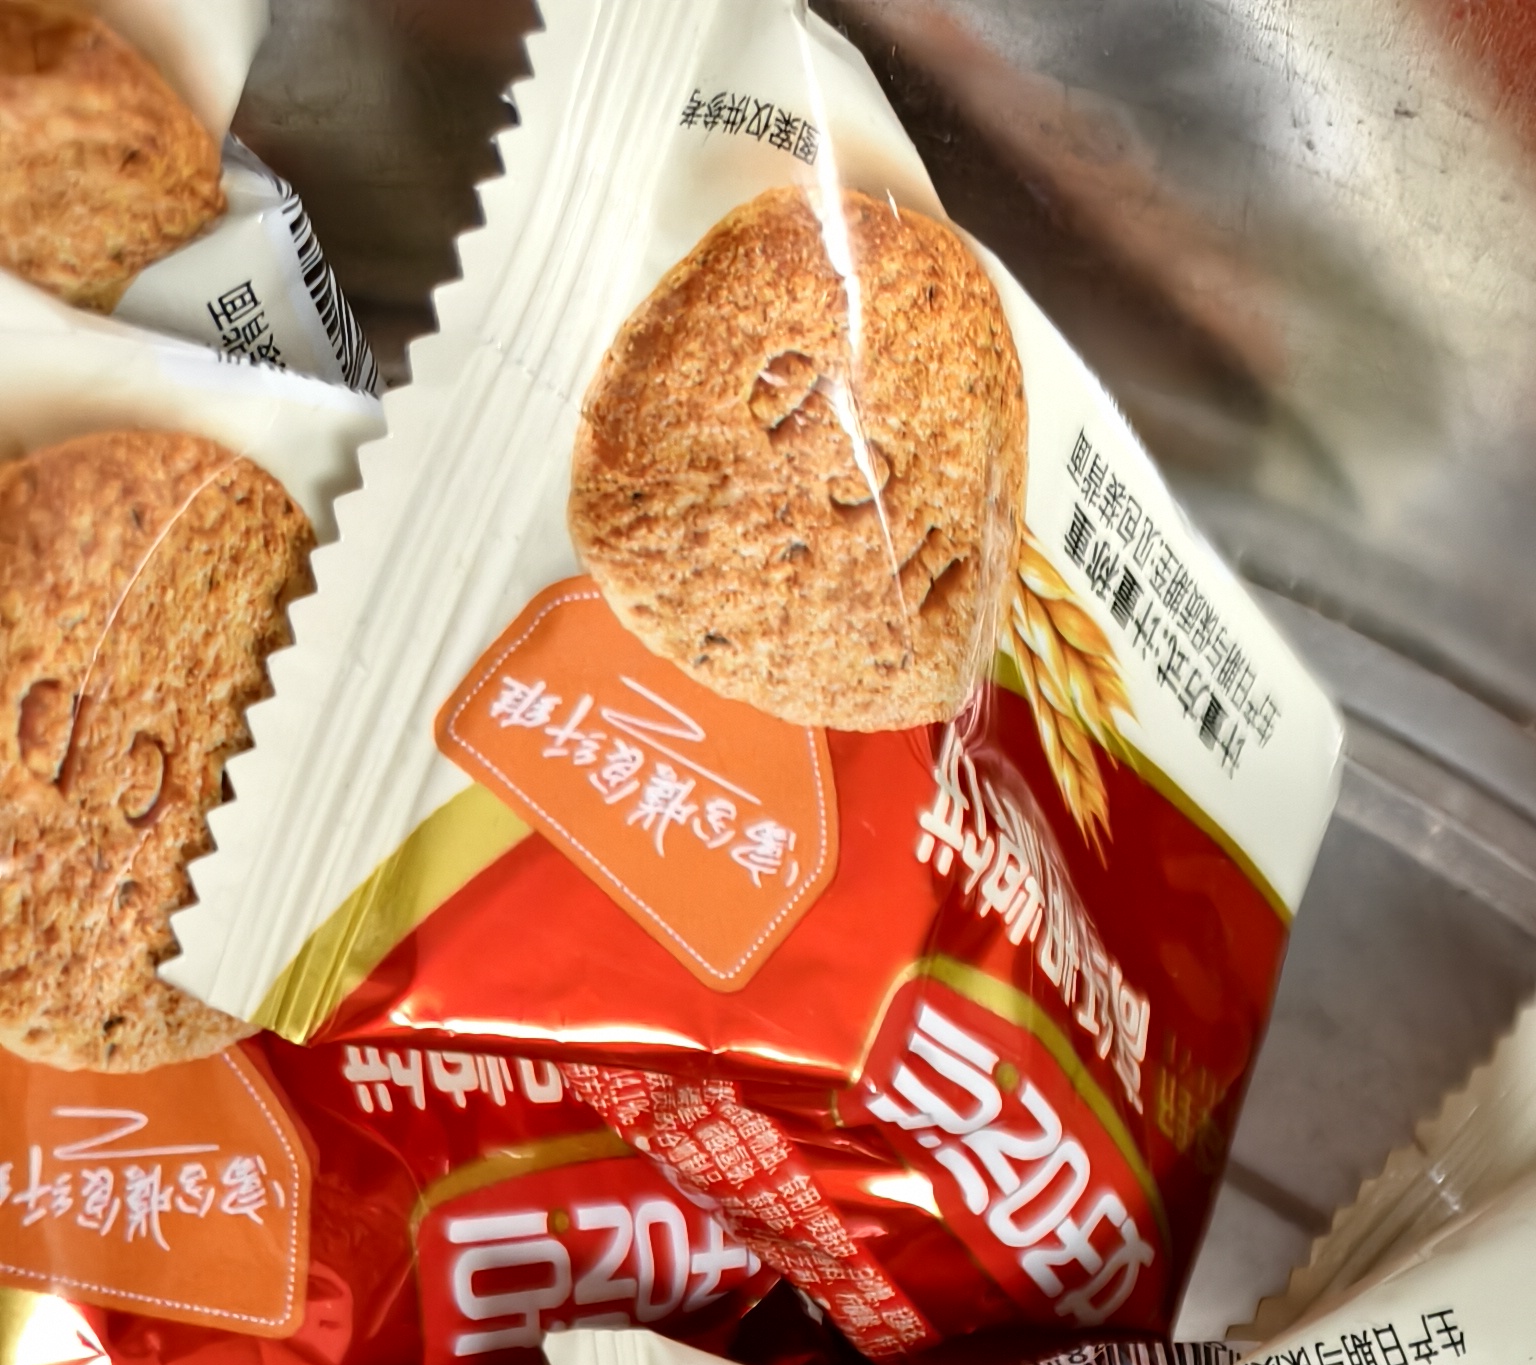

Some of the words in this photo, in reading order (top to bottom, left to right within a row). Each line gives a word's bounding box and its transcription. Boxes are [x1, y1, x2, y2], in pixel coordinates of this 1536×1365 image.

[0, 1147, 286, 1250] 富含膳食纤
